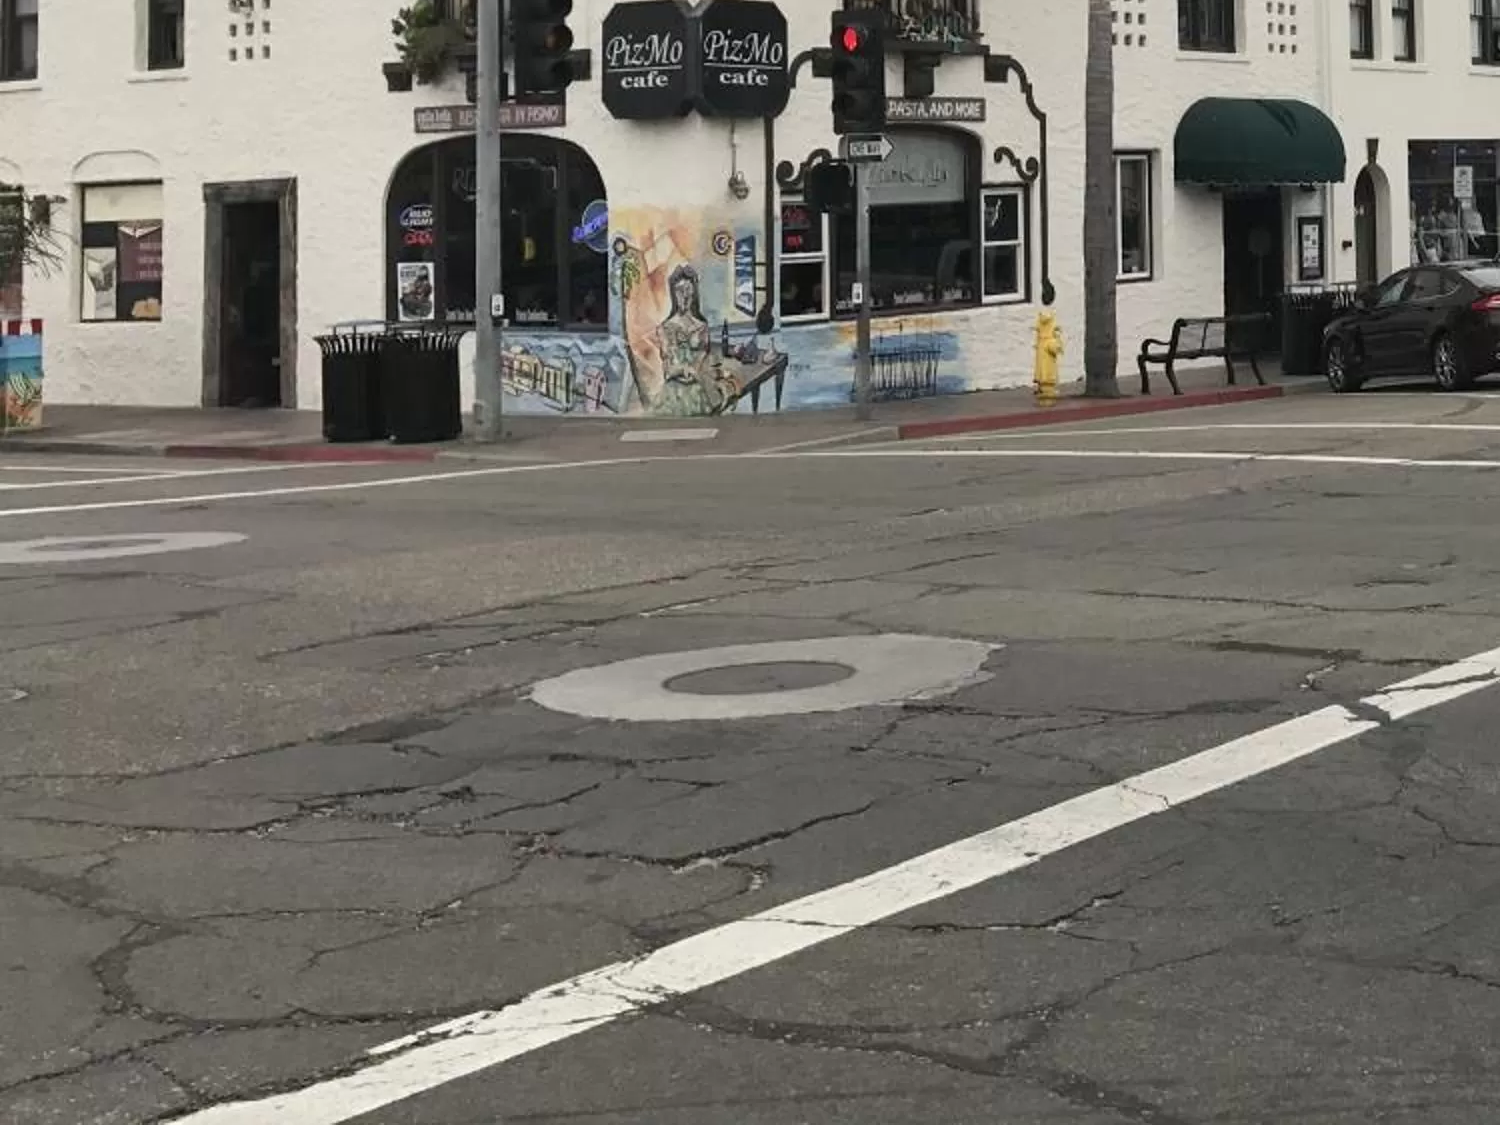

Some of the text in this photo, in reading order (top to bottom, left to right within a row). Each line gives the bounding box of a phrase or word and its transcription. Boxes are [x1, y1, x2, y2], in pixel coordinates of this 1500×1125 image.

[606, 31, 684, 67] PizMo
[703, 29, 783, 64] PizMo
[621, 71, 669, 89] cafe
[719, 68, 769, 86] cafe
[929, 101, 953, 117] AND
[955, 101, 981, 118] MORE
